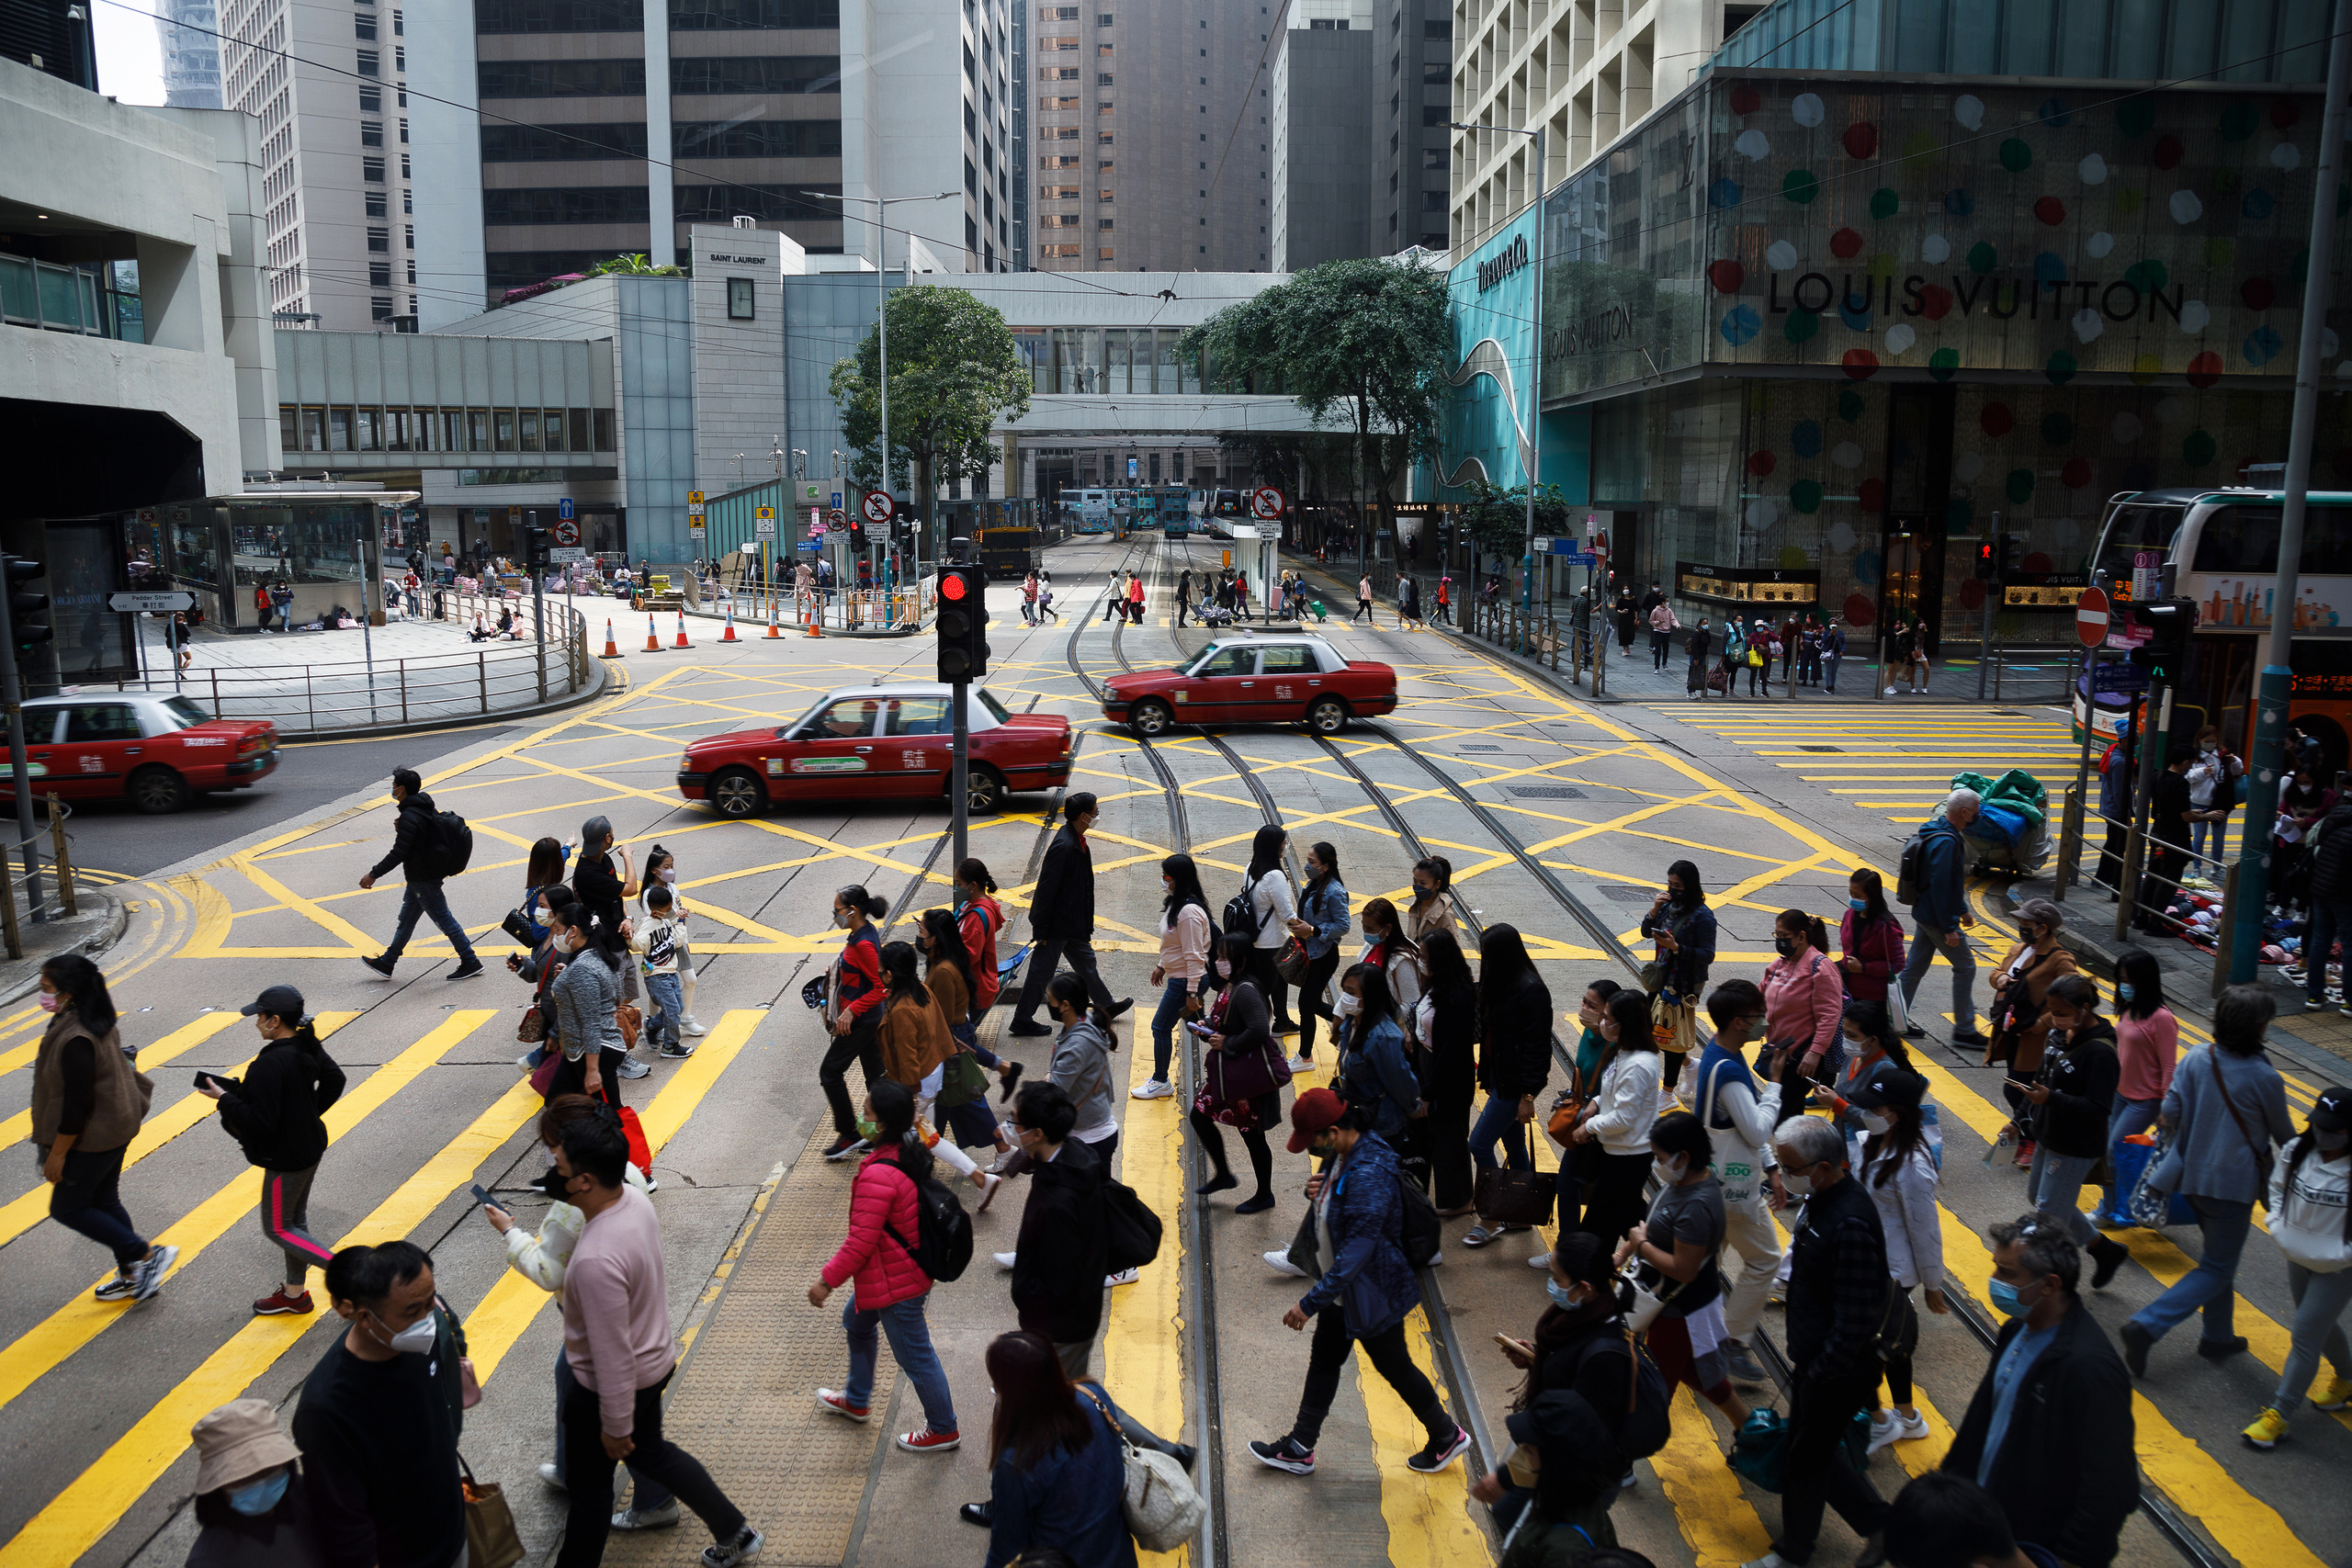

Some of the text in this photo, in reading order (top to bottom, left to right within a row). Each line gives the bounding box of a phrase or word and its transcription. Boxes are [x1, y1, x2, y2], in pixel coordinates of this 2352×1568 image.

[710, 254, 766, 265] SAINT LAURENT
[1770, 272, 2184, 324] LOUIS VUITTON
[1547, 302, 1632, 364] LOUIS VUITTON
[2146, 570, 2156, 598] 中環
[77, 594, 101, 604] ARMANI
[1724, 1167, 1751, 1177] ZOO
[1724, 1188, 1750, 1200] Wild
